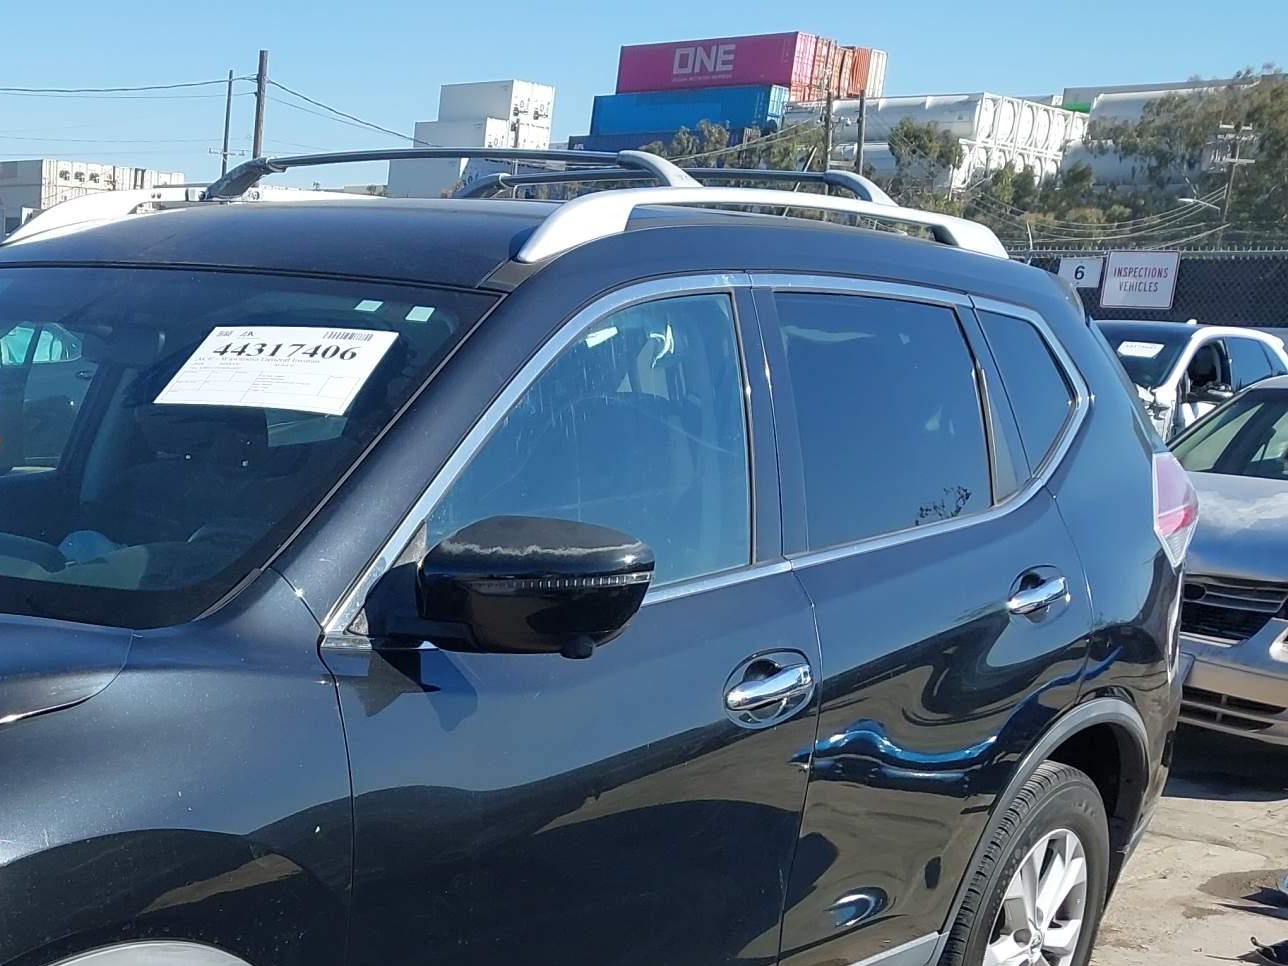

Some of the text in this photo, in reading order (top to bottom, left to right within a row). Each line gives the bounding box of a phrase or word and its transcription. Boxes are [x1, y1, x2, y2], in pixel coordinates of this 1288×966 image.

[673, 44, 736, 75] ONE
[1074, 265, 1085, 280] 6
[1113, 266, 1169, 279] INSPECTIONS
[1119, 281, 1159, 293] VEHICLES
[212, 341, 361, 361] 44317406
